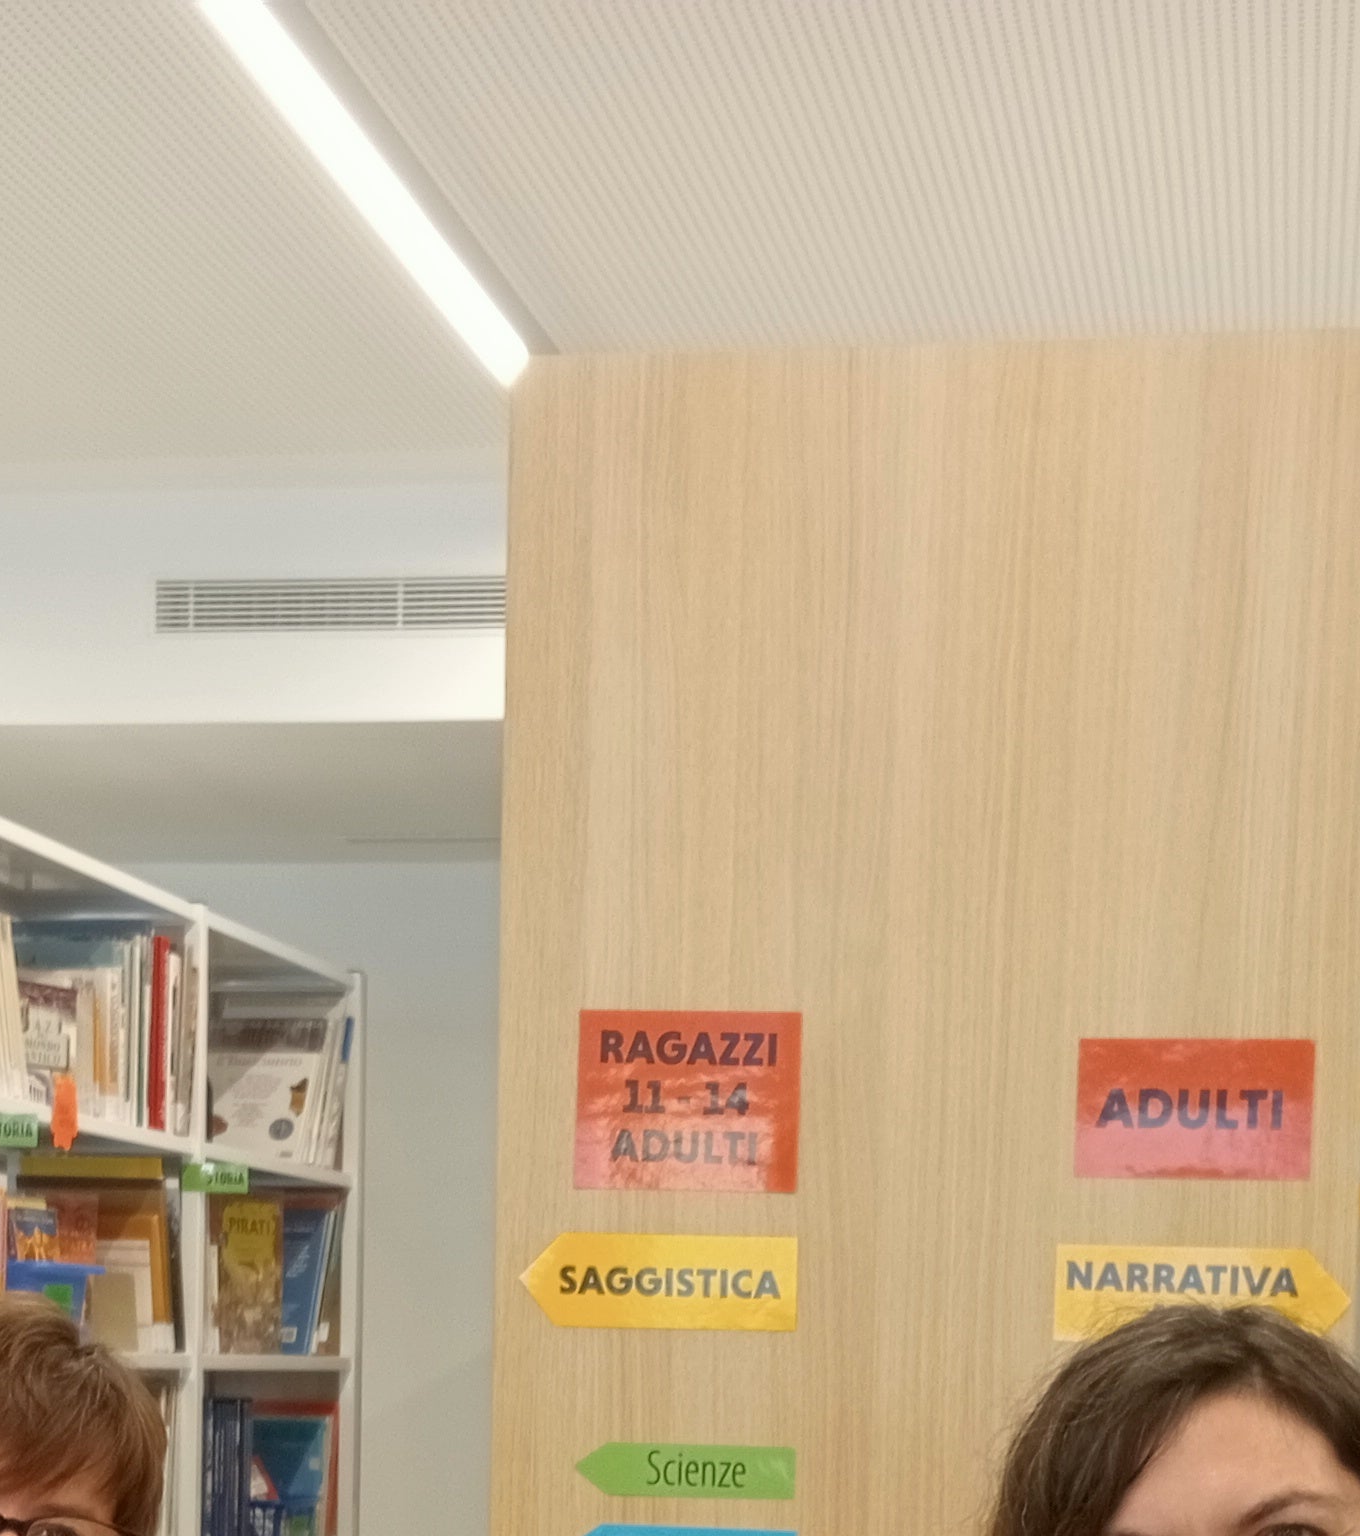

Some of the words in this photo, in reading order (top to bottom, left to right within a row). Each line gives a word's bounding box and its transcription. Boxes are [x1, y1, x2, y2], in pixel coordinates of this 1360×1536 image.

[598, 1027, 779, 1069] RAGAZZI
[622, 1080, 667, 1115] 11
[702, 1081, 751, 1117] 14
[1096, 1087, 1285, 1132] ADULTI
[610, 1129, 760, 1168] ADULTI
[558, 1265, 782, 1301] SAGGISTICA
[1066, 1260, 1298, 1298] NARRATIVA
[645, 1449, 748, 1491] Scienze
